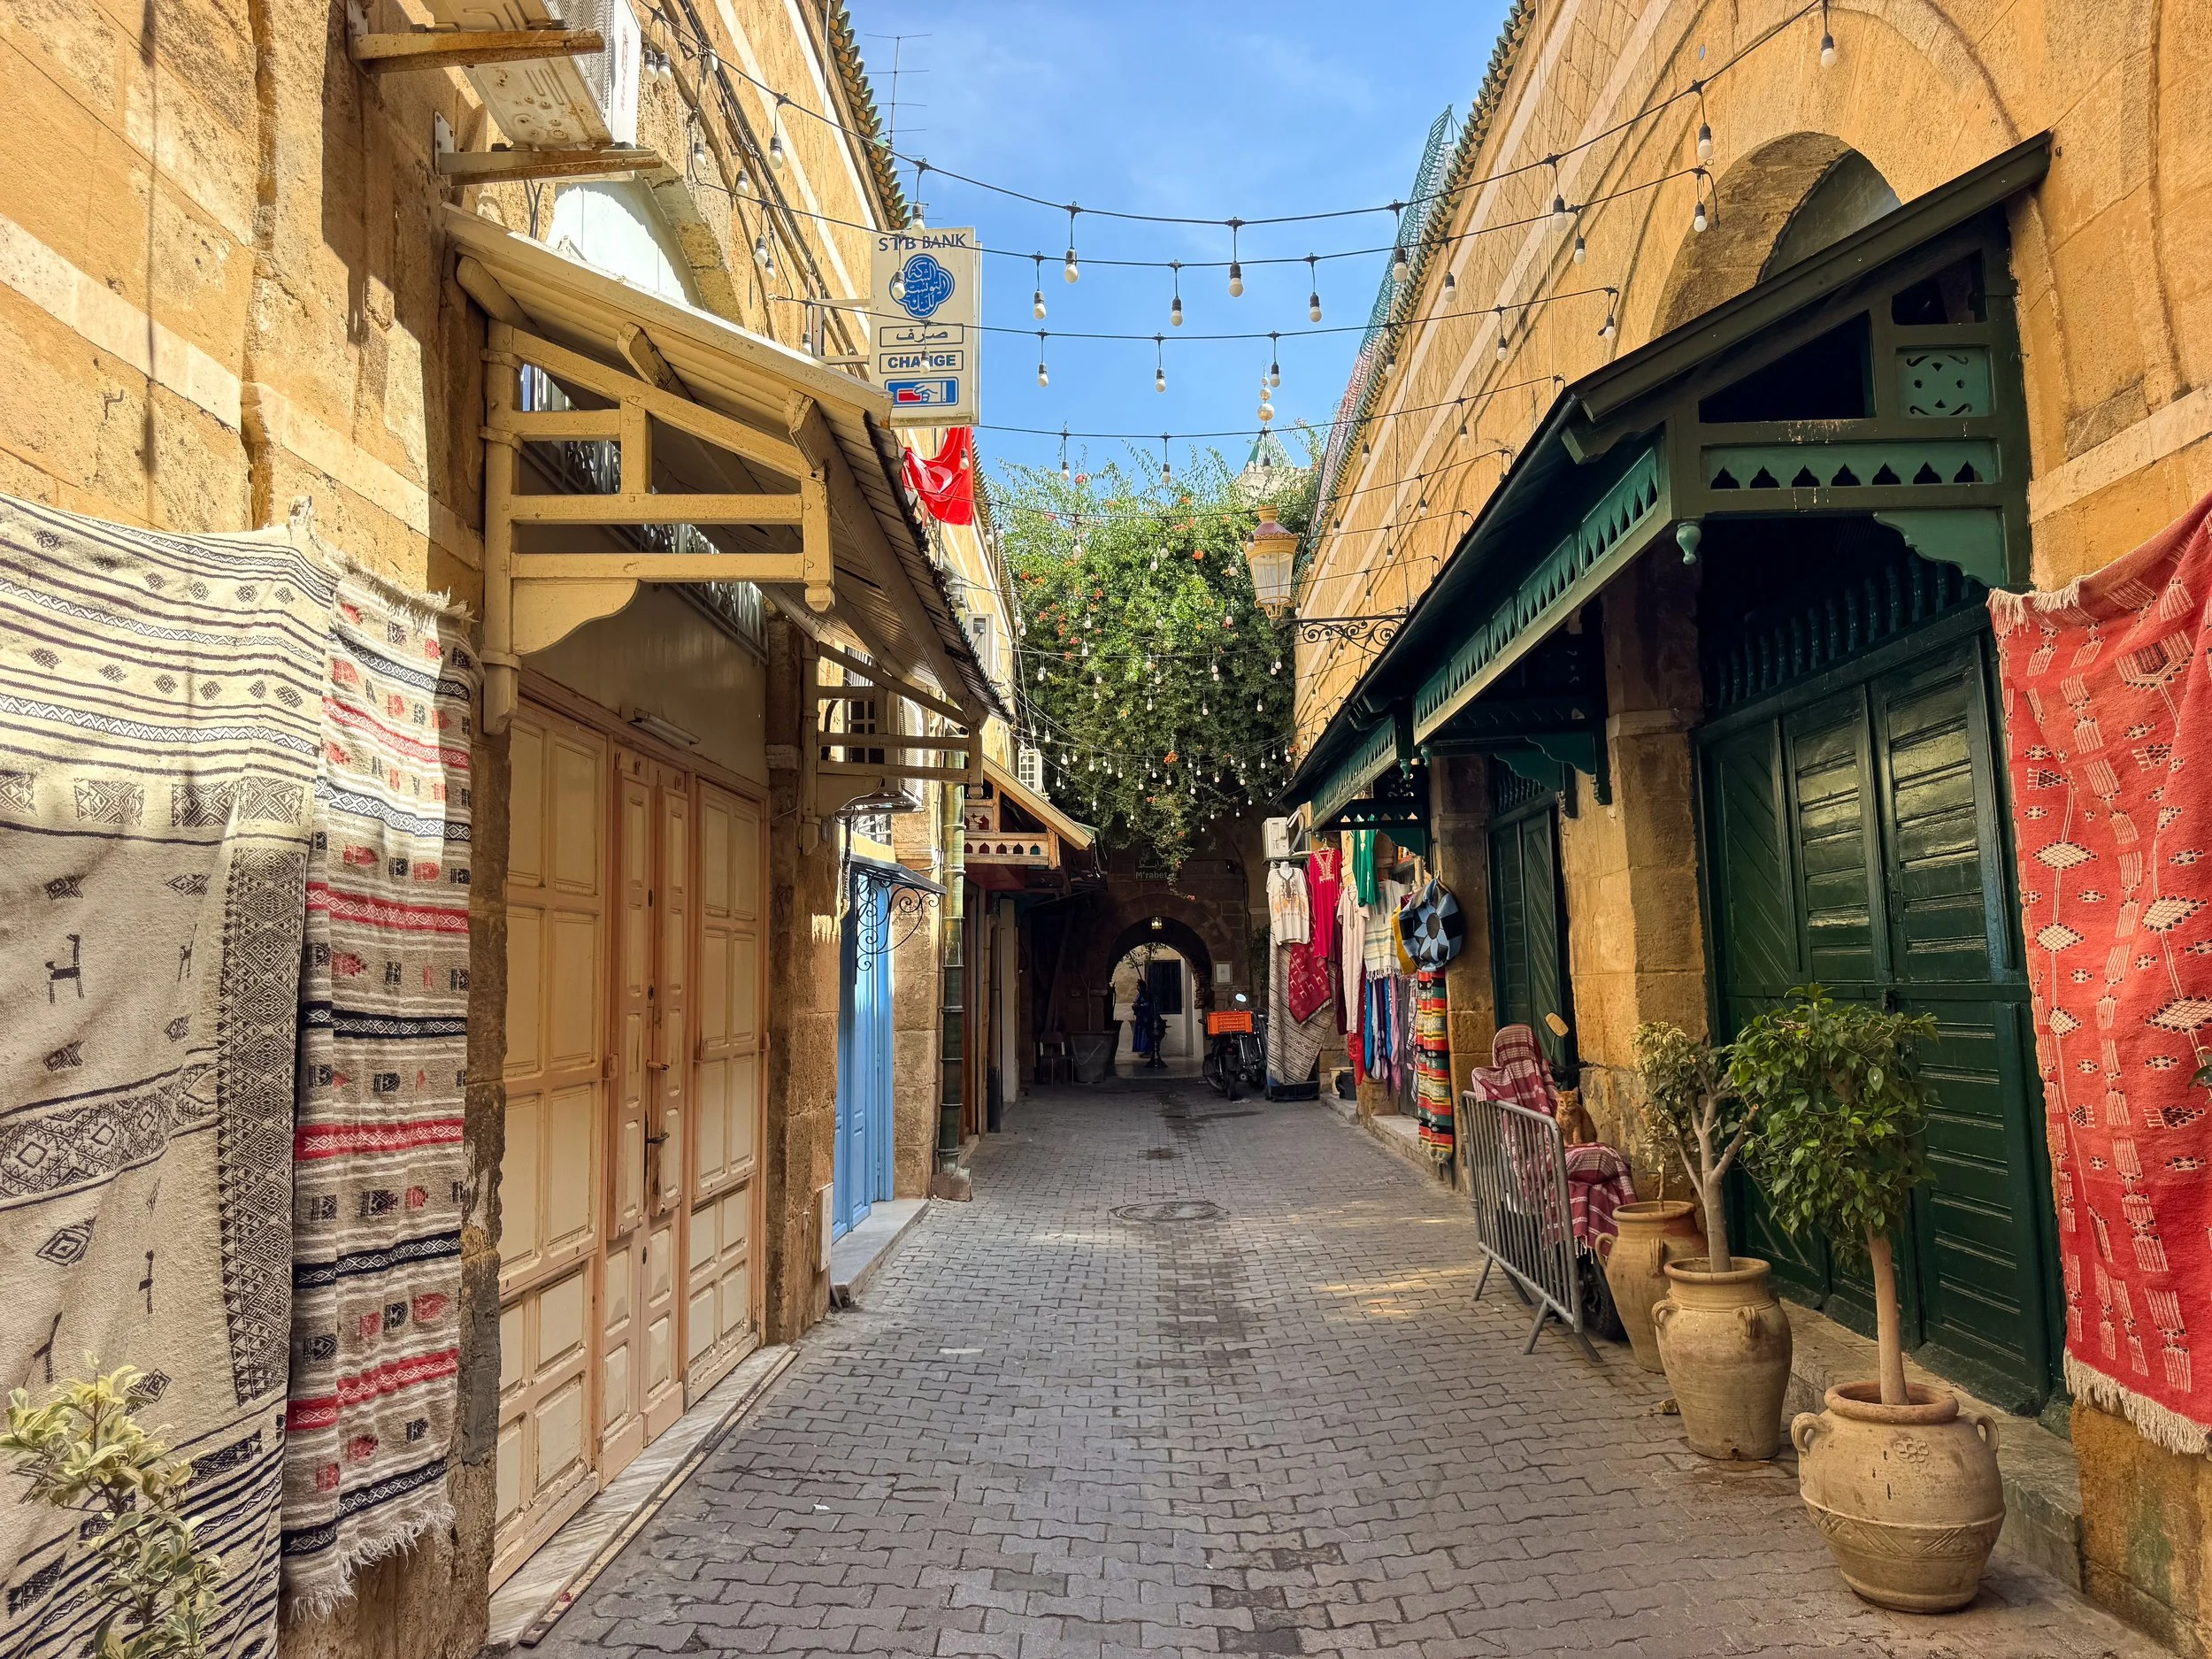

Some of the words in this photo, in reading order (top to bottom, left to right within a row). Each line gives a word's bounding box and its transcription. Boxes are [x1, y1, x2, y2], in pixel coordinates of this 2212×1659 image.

[879, 236, 917, 252] STB
[922, 234, 967, 249] BANK
[903, 273, 949, 297] التونسي
[896, 328, 949, 342] صرف
[1135, 870, 1168, 879] M'rabet
